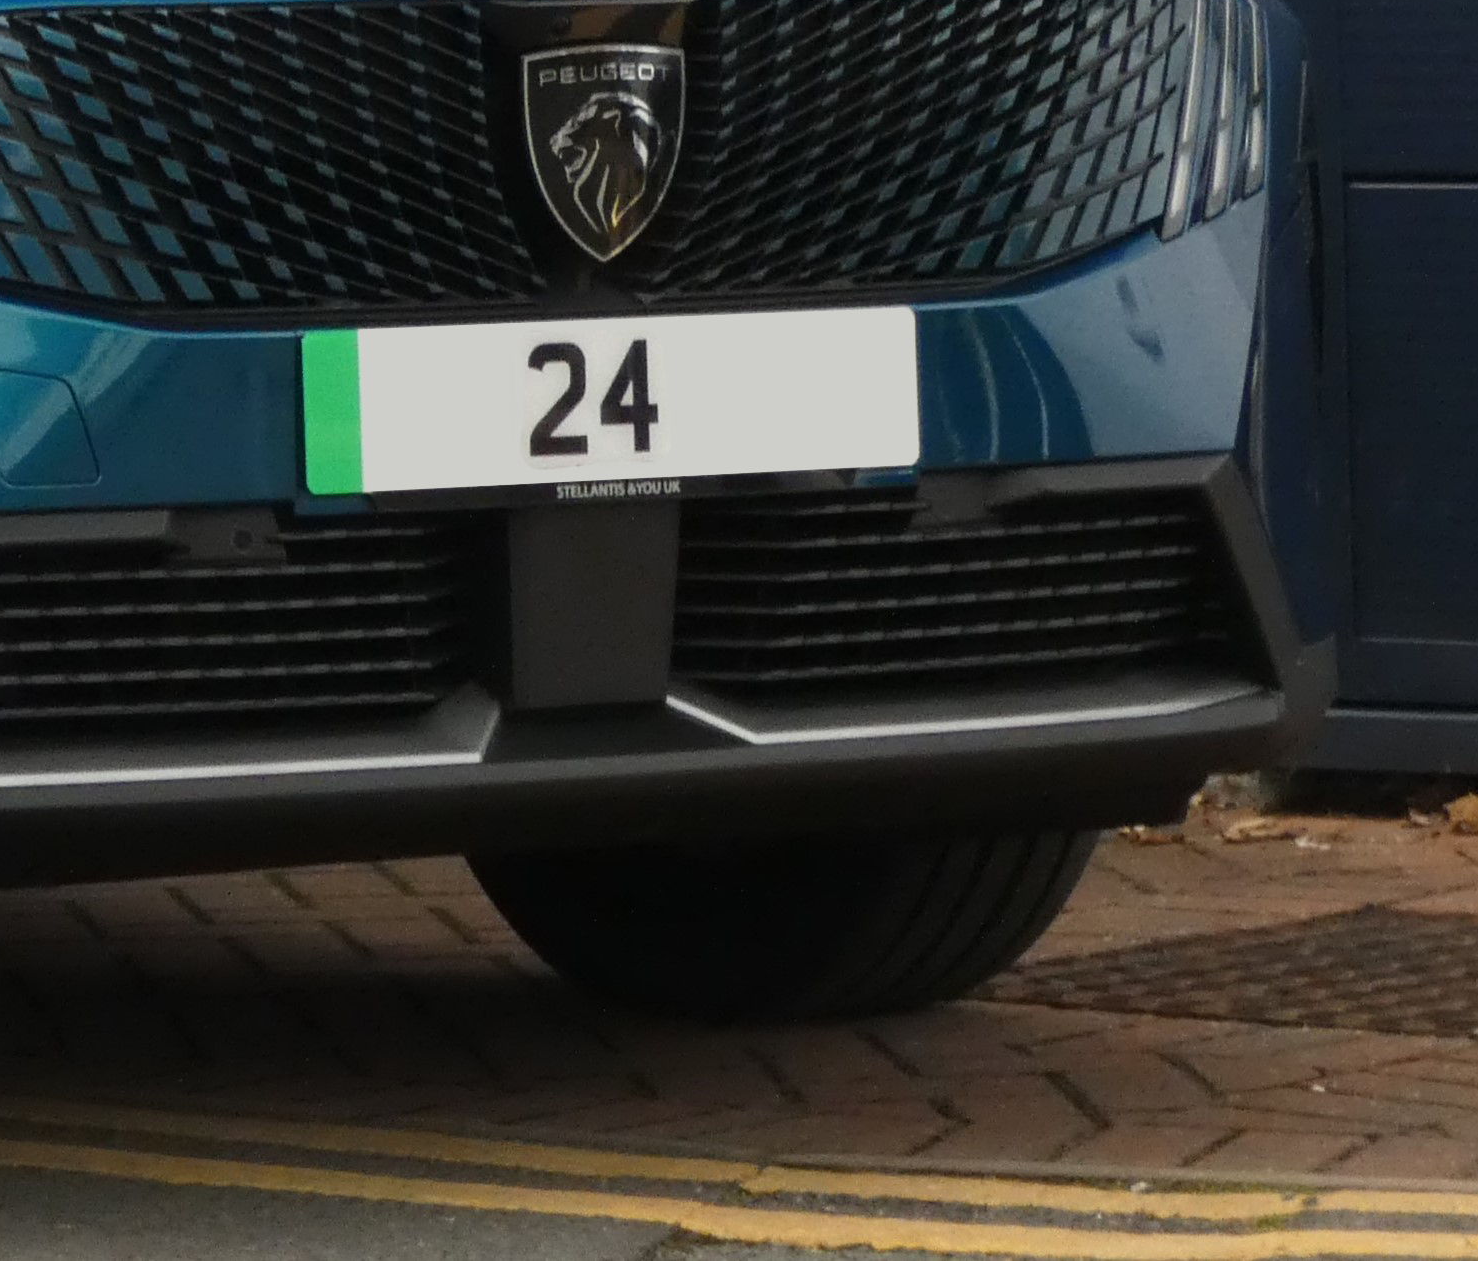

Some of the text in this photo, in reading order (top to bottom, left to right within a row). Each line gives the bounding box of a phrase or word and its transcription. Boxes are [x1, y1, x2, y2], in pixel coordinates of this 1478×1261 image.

[539, 63, 668, 87] PEUGEOT
[526, 339, 659, 457] 24
[556, 482, 626, 499] STELLANTIS
[663, 480, 681, 494] UK
